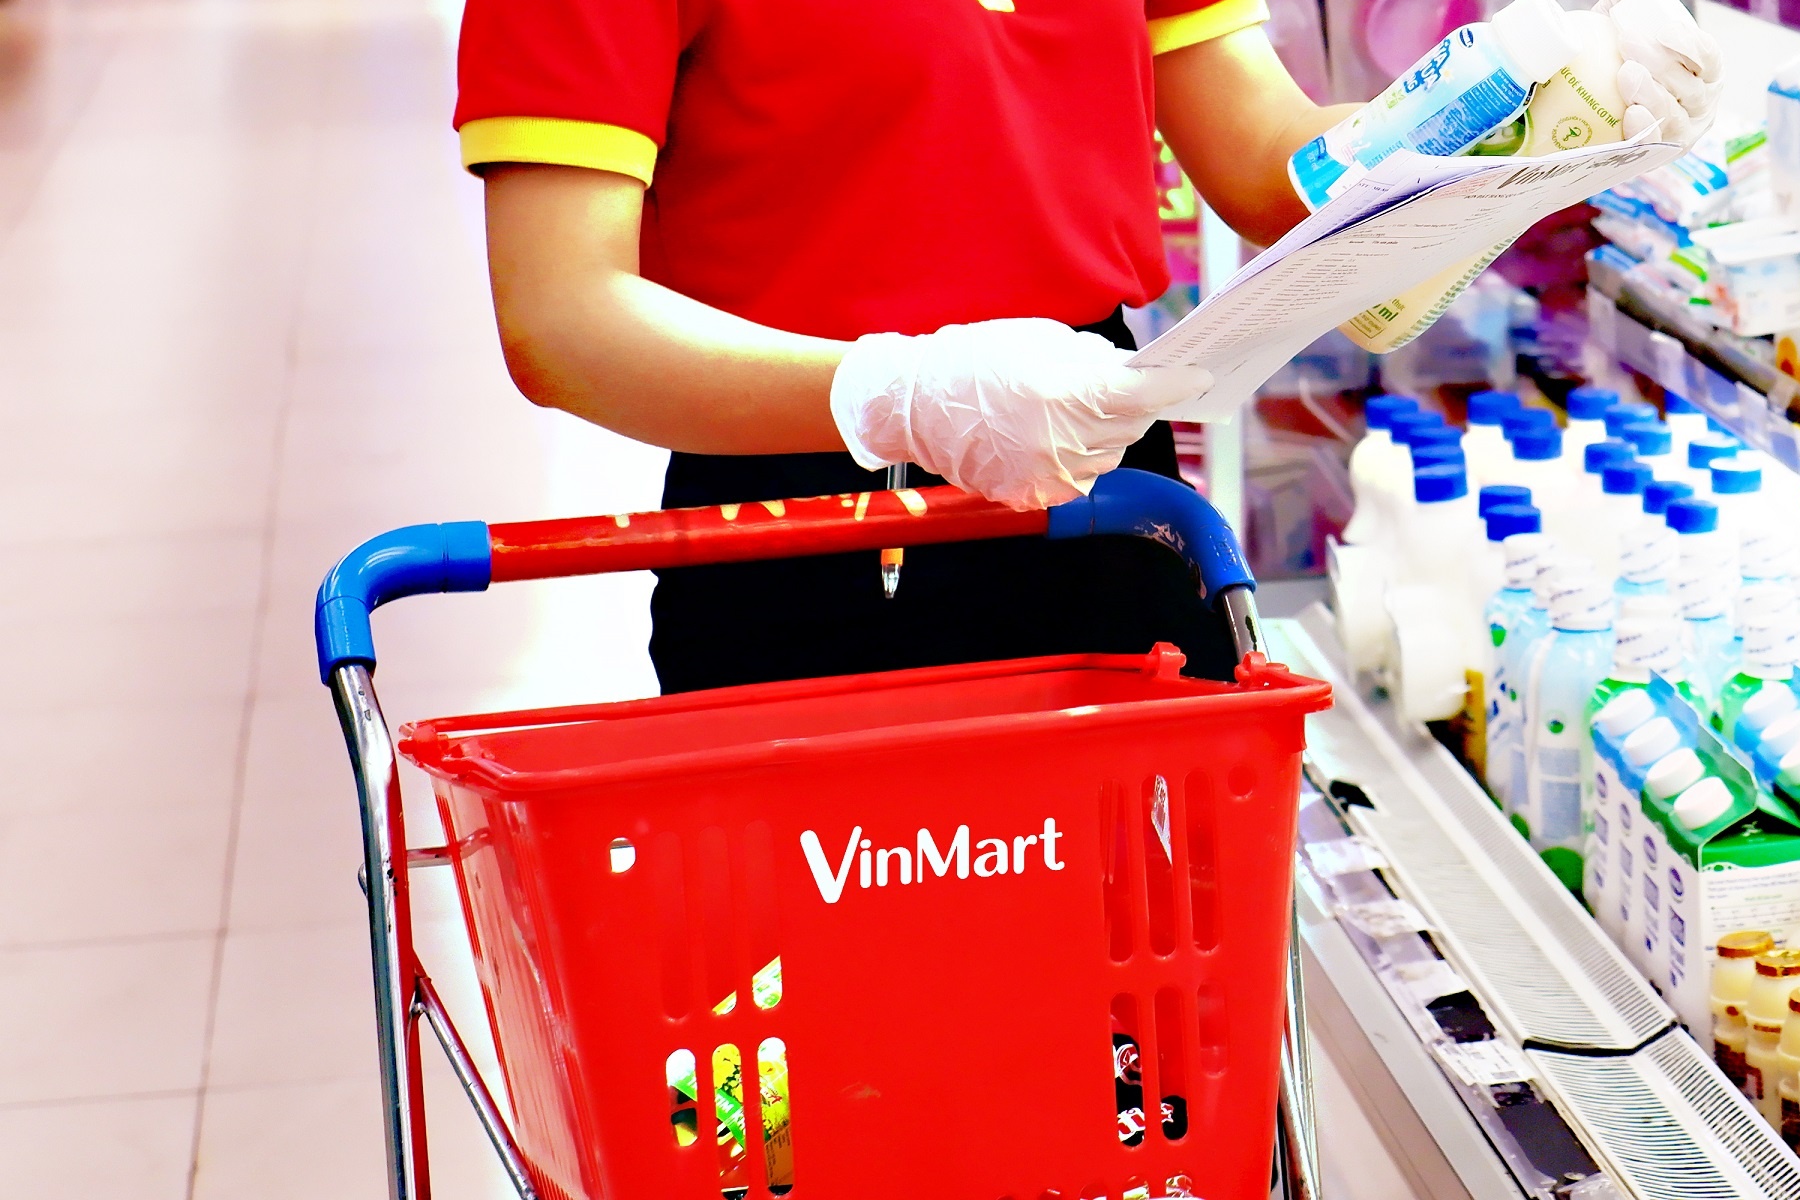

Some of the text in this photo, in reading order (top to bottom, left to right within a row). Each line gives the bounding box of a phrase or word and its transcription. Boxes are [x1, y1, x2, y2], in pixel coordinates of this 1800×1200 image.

[1576, 86, 1600, 111] KHÁNG
[1378, 306, 1400, 322] ml
[800, 817, 1065, 904] VinMart
